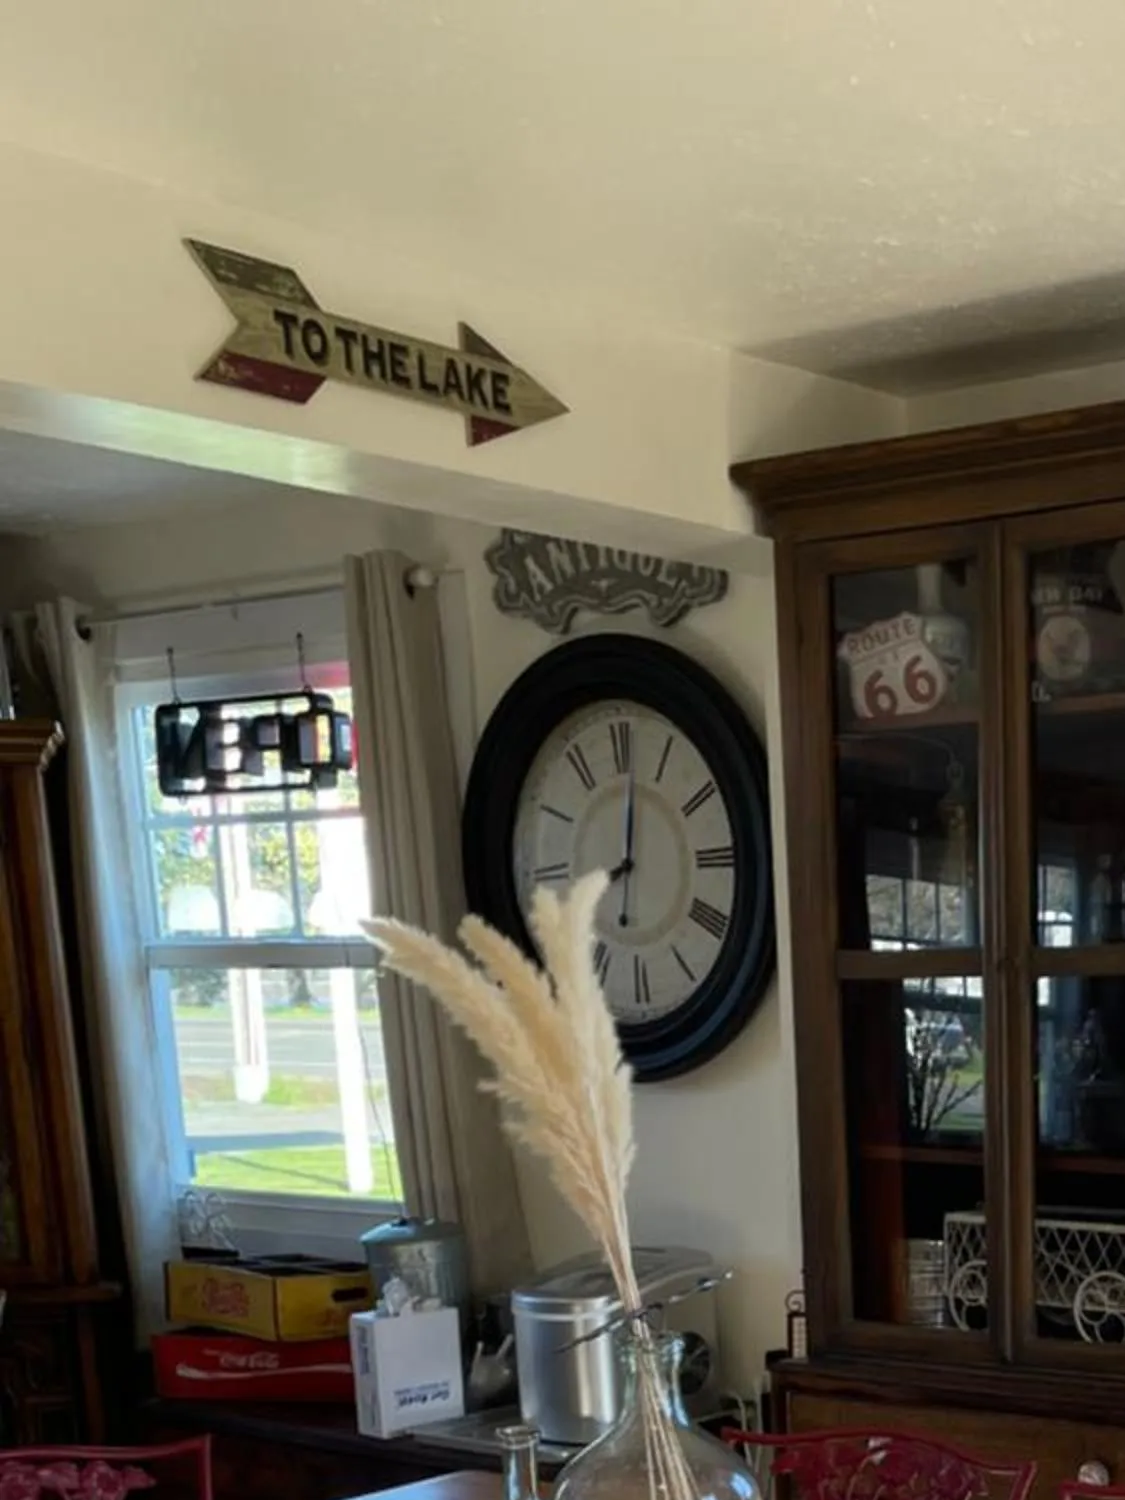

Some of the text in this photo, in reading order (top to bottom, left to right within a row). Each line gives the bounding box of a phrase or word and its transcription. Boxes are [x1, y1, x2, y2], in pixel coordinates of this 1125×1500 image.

[273, 308, 512, 415] TO THE LAKE
[846, 617, 916, 655] ROUTE
[863, 655, 938, 717] 66
